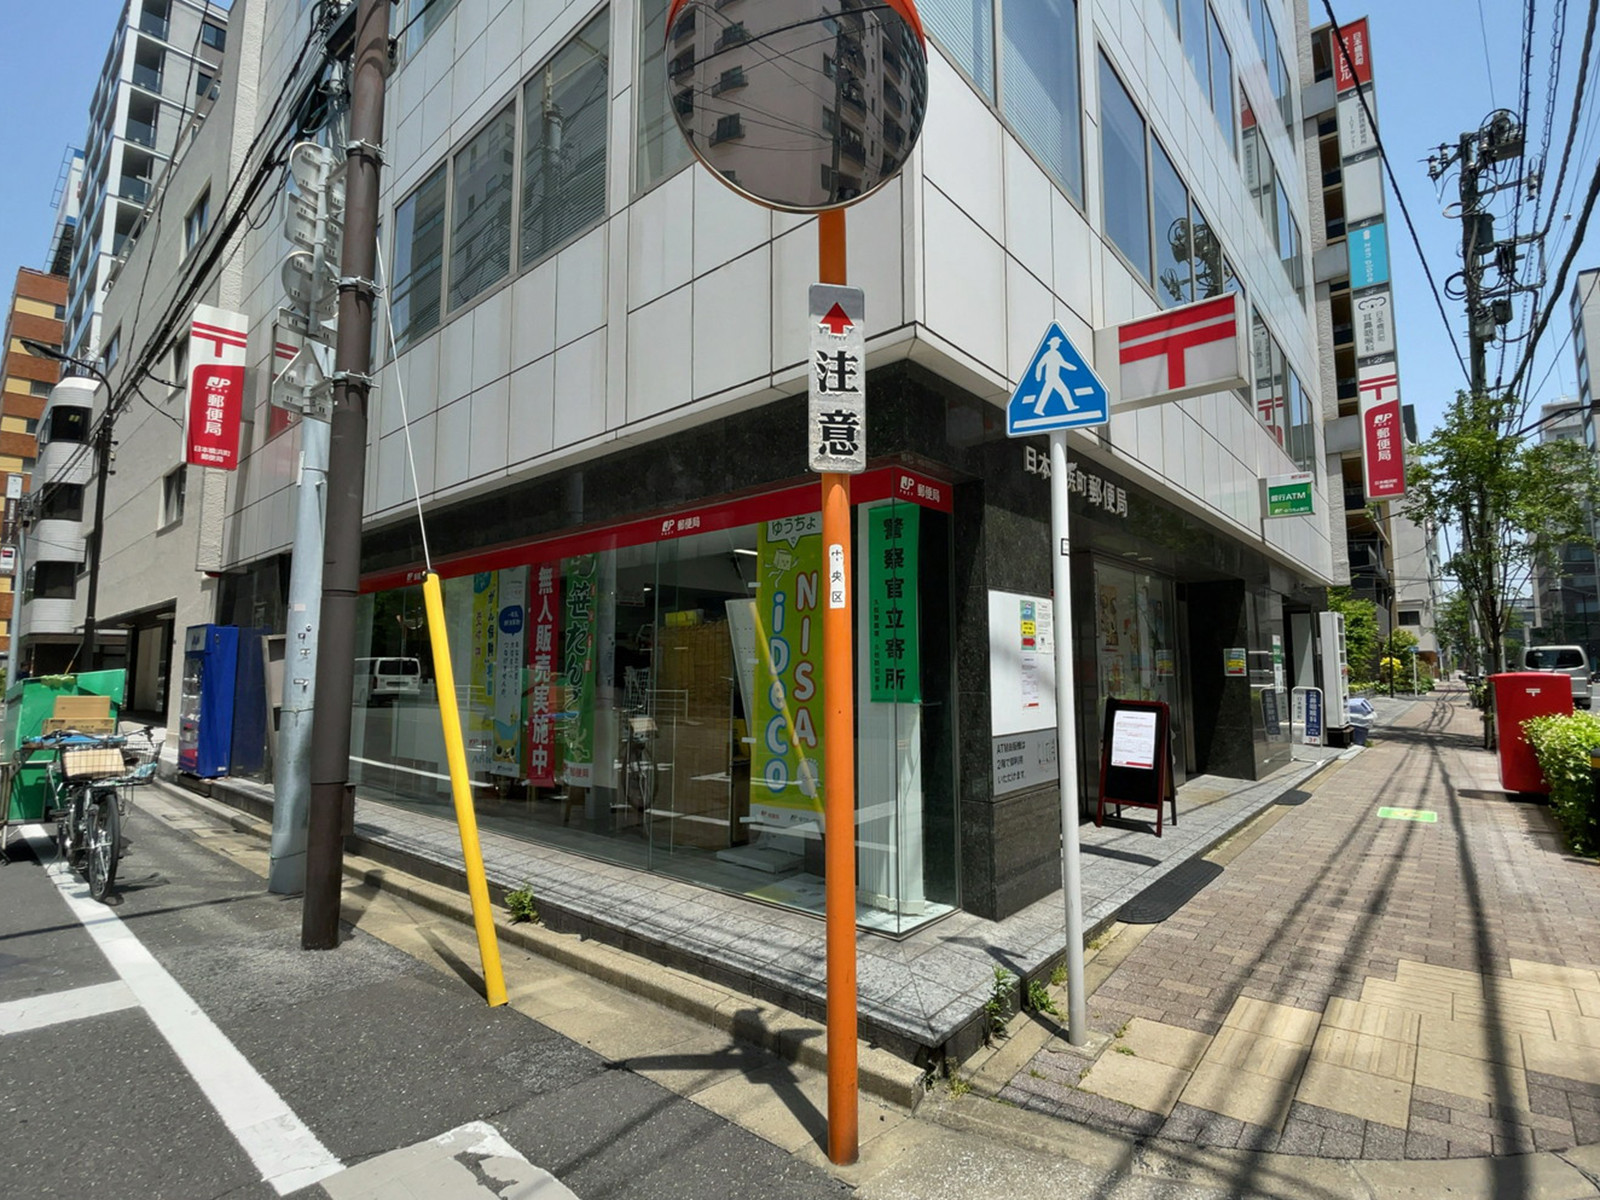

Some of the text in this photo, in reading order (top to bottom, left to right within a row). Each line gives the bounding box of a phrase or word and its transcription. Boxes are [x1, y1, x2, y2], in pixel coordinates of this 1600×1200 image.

[204, 393, 225, 437] 郵便局
[816, 349, 861, 456] 注意
[1376, 427, 1392, 462] 郵便局
[677, 515, 701, 532] 郵便局
[771, 516, 817, 536] ゆうちょ
[917, 483, 941, 503] 郵便局
[883, 516, 905, 691] 警察官立寄所
[531, 567, 553, 775] 無人販売実施中
[764, 590, 791, 794] iDeCo
[792, 570, 818, 749] NISA
